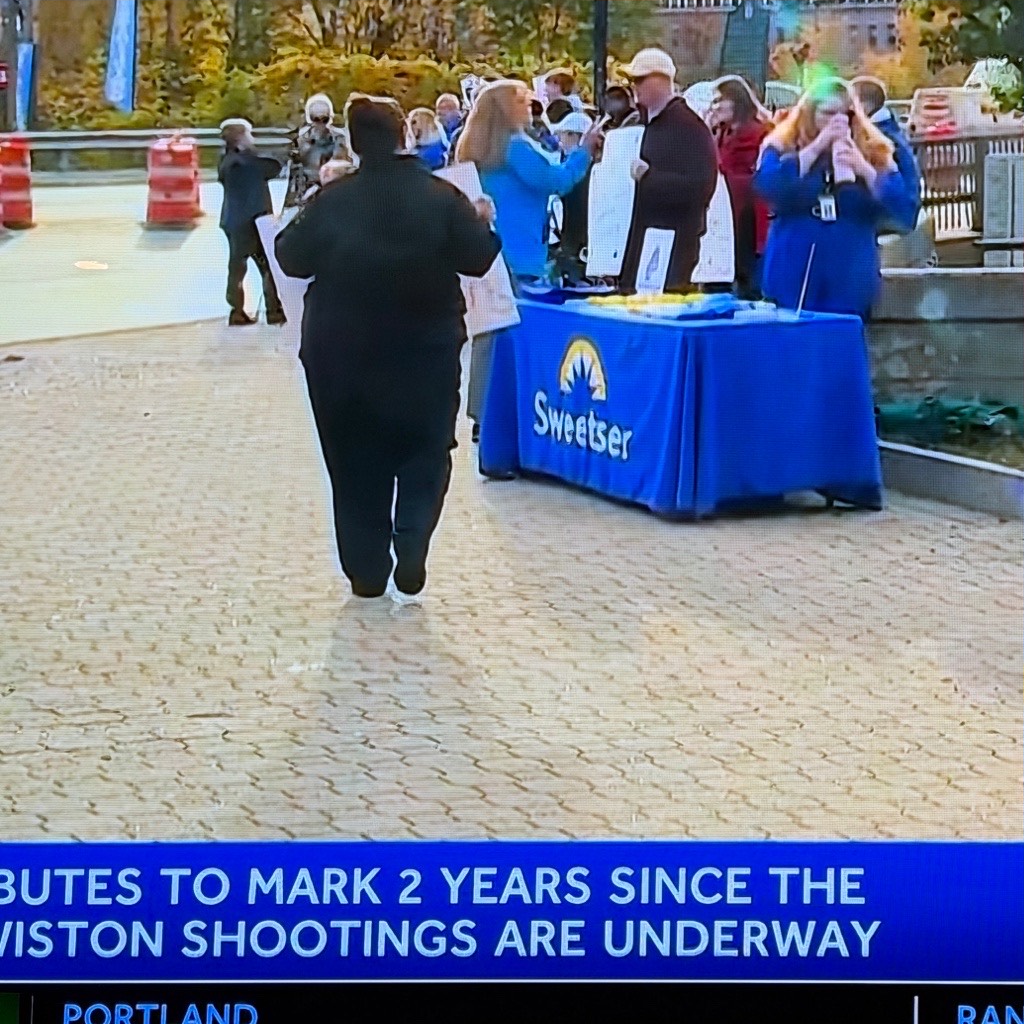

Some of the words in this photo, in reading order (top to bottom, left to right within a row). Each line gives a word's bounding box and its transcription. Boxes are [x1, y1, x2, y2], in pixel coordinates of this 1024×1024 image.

[533, 389, 634, 460] Sweetser
[159, 867, 231, 906] TO
[247, 867, 382, 905] MARK
[398, 868, 422, 904] 2
[440, 866, 591, 905] YEARS
[609, 866, 752, 905] SINCE
[768, 867, 866, 905] THE
[0, 920, 164, 958] ISTON
[181, 919, 477, 958] SHOOTINGS
[494, 919, 586, 957] ARE
[604, 919, 882, 958] UNDERWAY
[63, 1003, 258, 1024] PORTLAND
